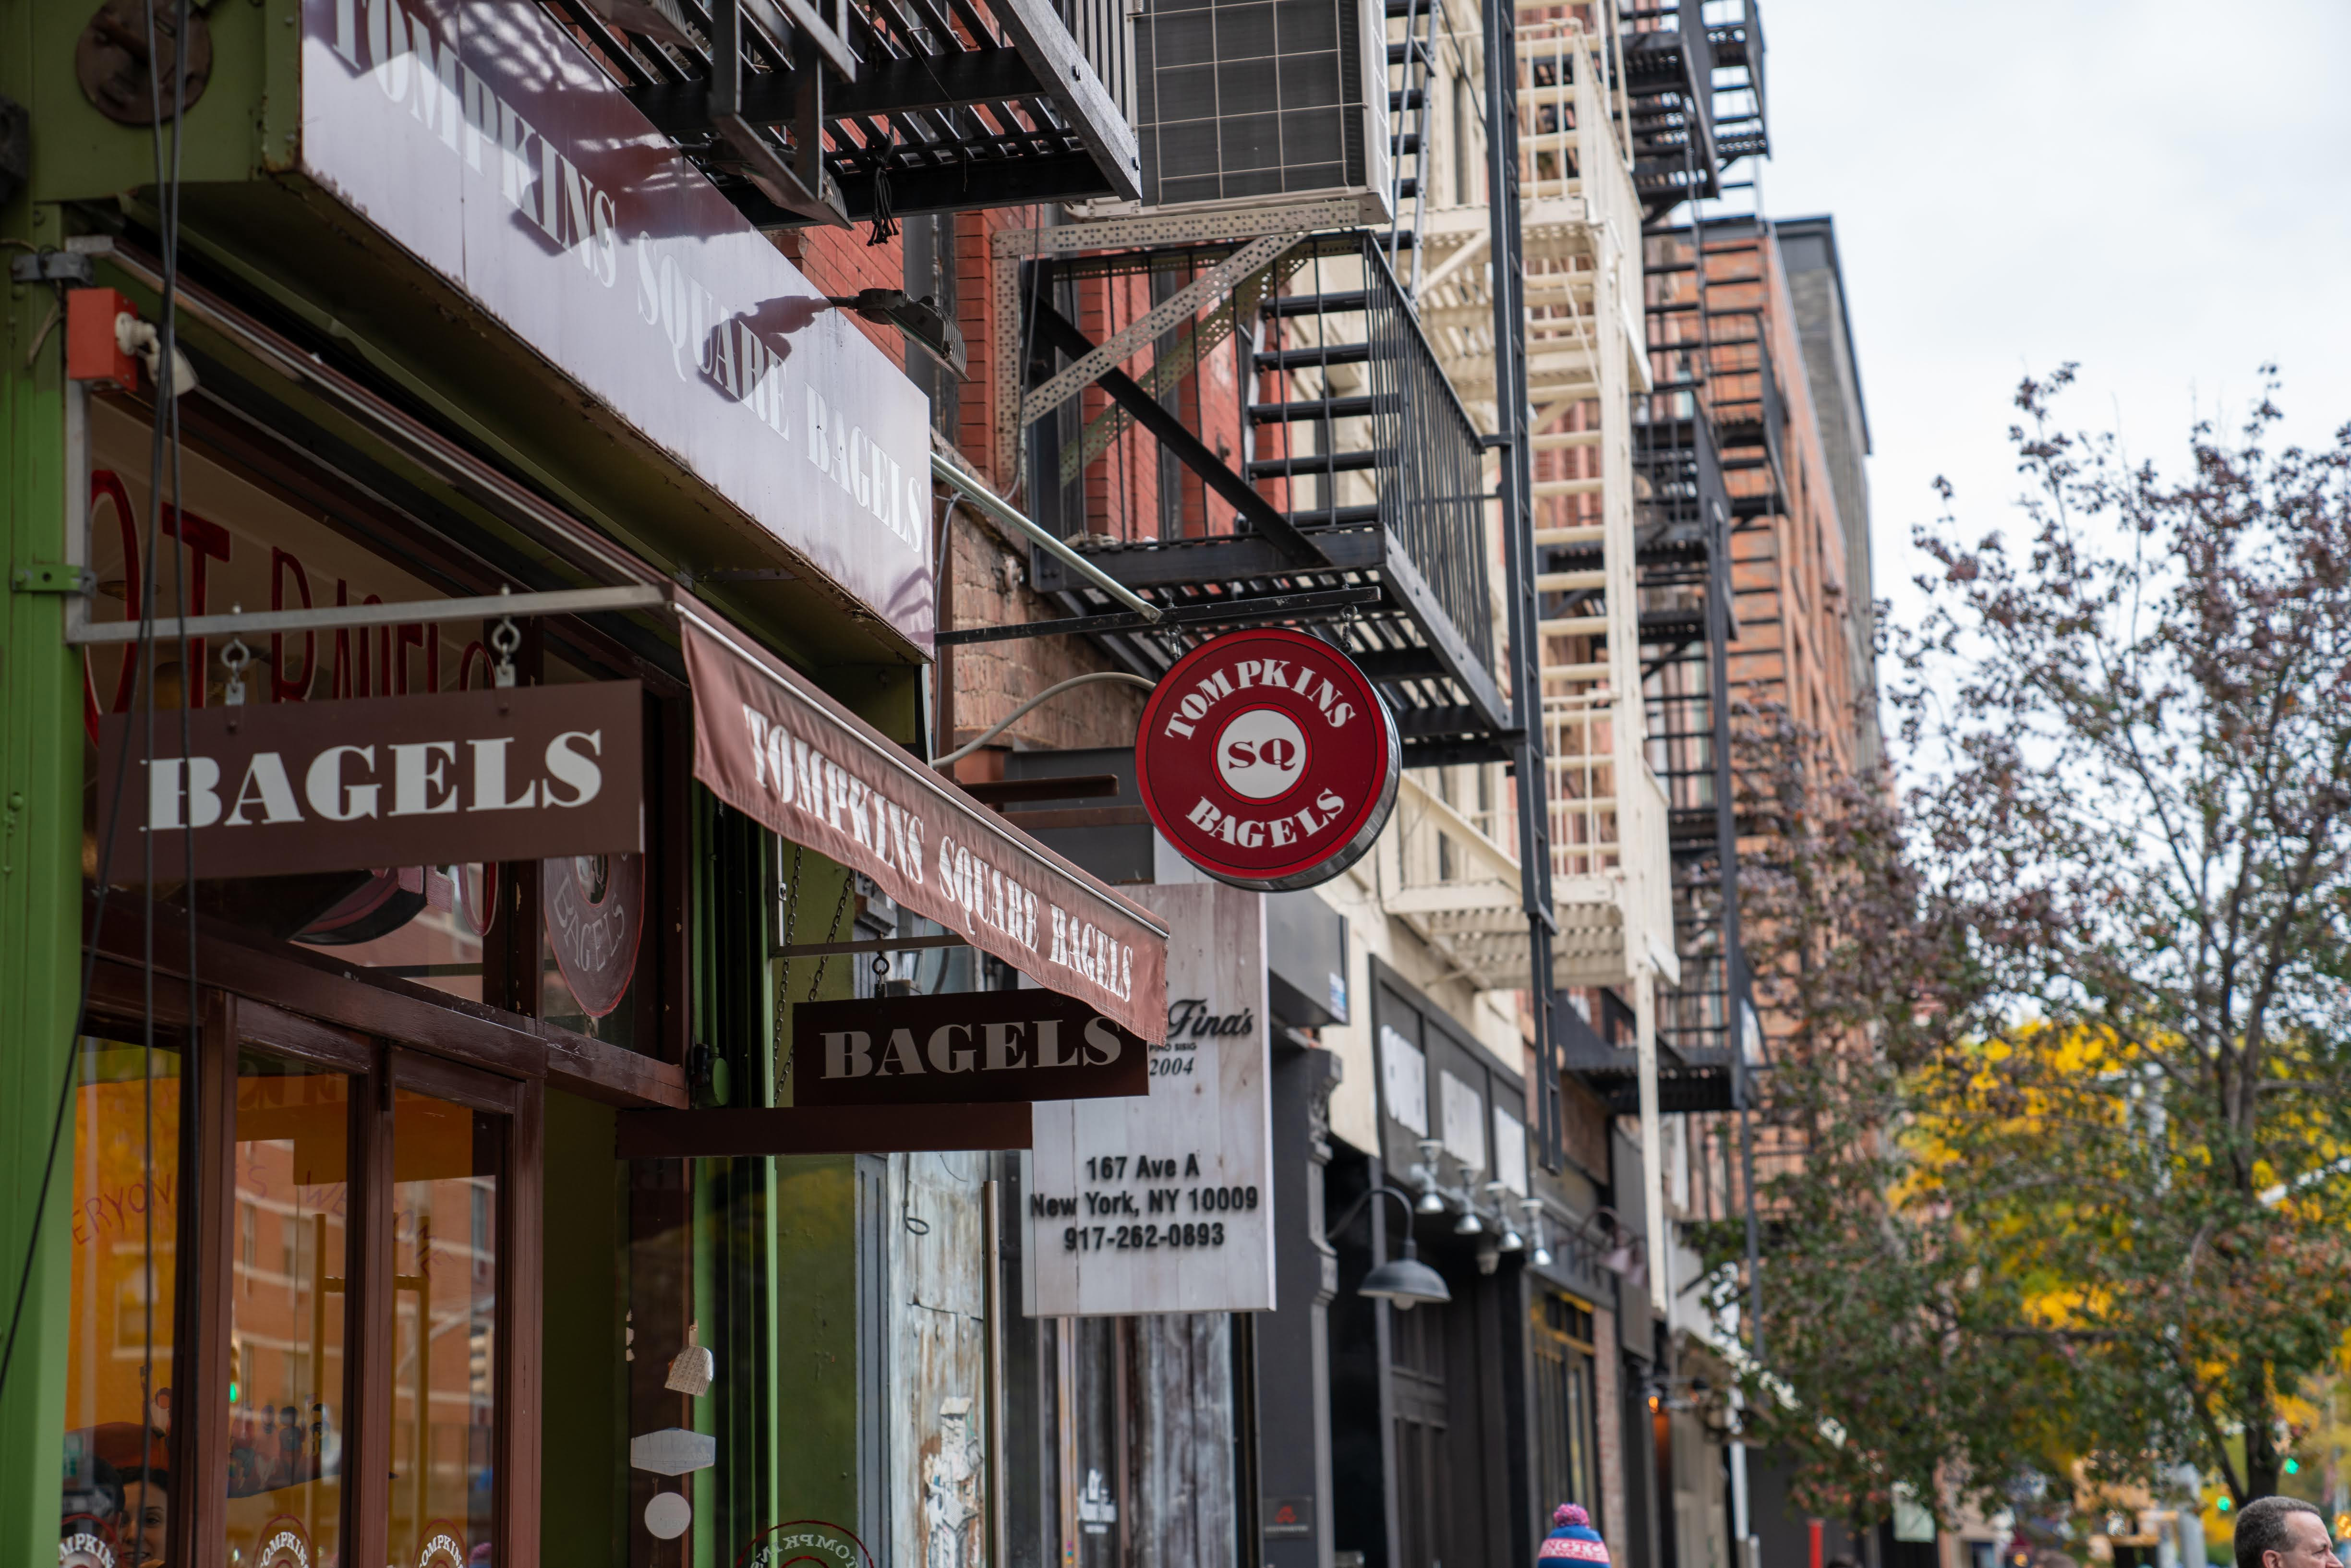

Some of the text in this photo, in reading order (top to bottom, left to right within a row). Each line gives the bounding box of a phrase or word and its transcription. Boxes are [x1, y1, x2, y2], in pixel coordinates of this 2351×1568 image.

[332, 0, 923, 553] TOMPKINS SQUARE BAGELS
[1164, 658, 1356, 740] TOMPKINS
[1228, 738, 1296, 772] SQ
[139, 728, 602, 832] BAGELS
[1184, 787, 1345, 848] BAGELS
[742, 704, 1133, 1002] TOMPKINS SQUARE BAGELS
[819, 1016, 1122, 1080] BAGELS
[1149, 1057, 1194, 1076] 2004
[1086, 1153, 1200, 1181] 167 Ave A
[1031, 1186, 1258, 1218] New York, NY 10009
[1063, 1222, 1225, 1251] 917-262-0893
[259, 1531, 309, 1568] OMPKIN
[419, 1534, 464, 1568] OMPKIN
